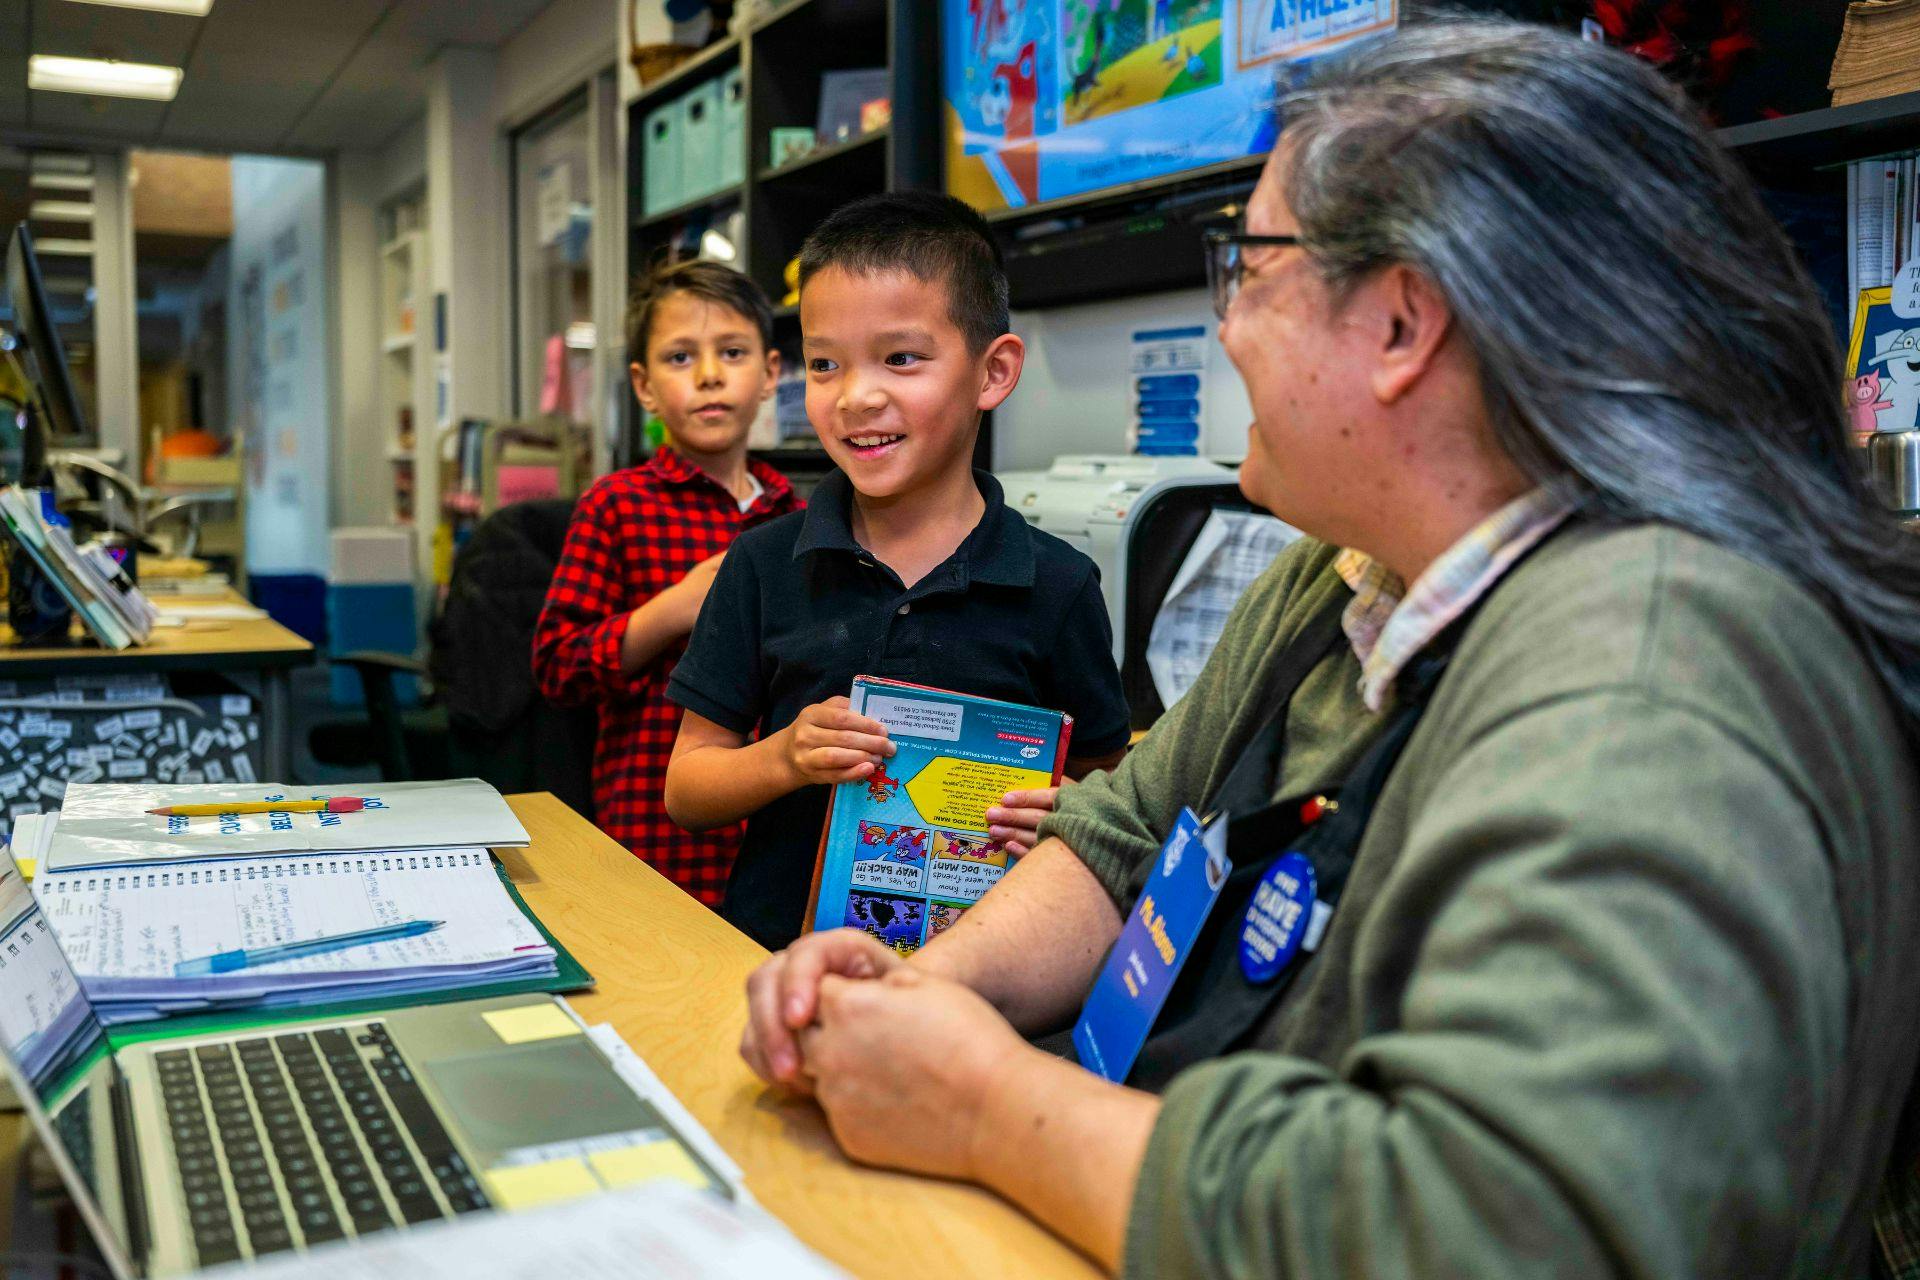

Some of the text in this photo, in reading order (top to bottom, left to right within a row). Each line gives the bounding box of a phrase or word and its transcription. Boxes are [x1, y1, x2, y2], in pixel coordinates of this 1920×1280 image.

[879, 717, 899, 726] Library
[921, 716, 941, 724] Jackson
[997, 733, 1039, 744] SCHOLASTIC
[999, 756, 1024, 765] EXPLORE
[855, 862, 918, 878] WAY BACK!!!
[933, 860, 960, 871] MAN!
[961, 864, 980, 875] DOG
[932, 871, 961, 884] friends
[964, 876, 983, 884] were
